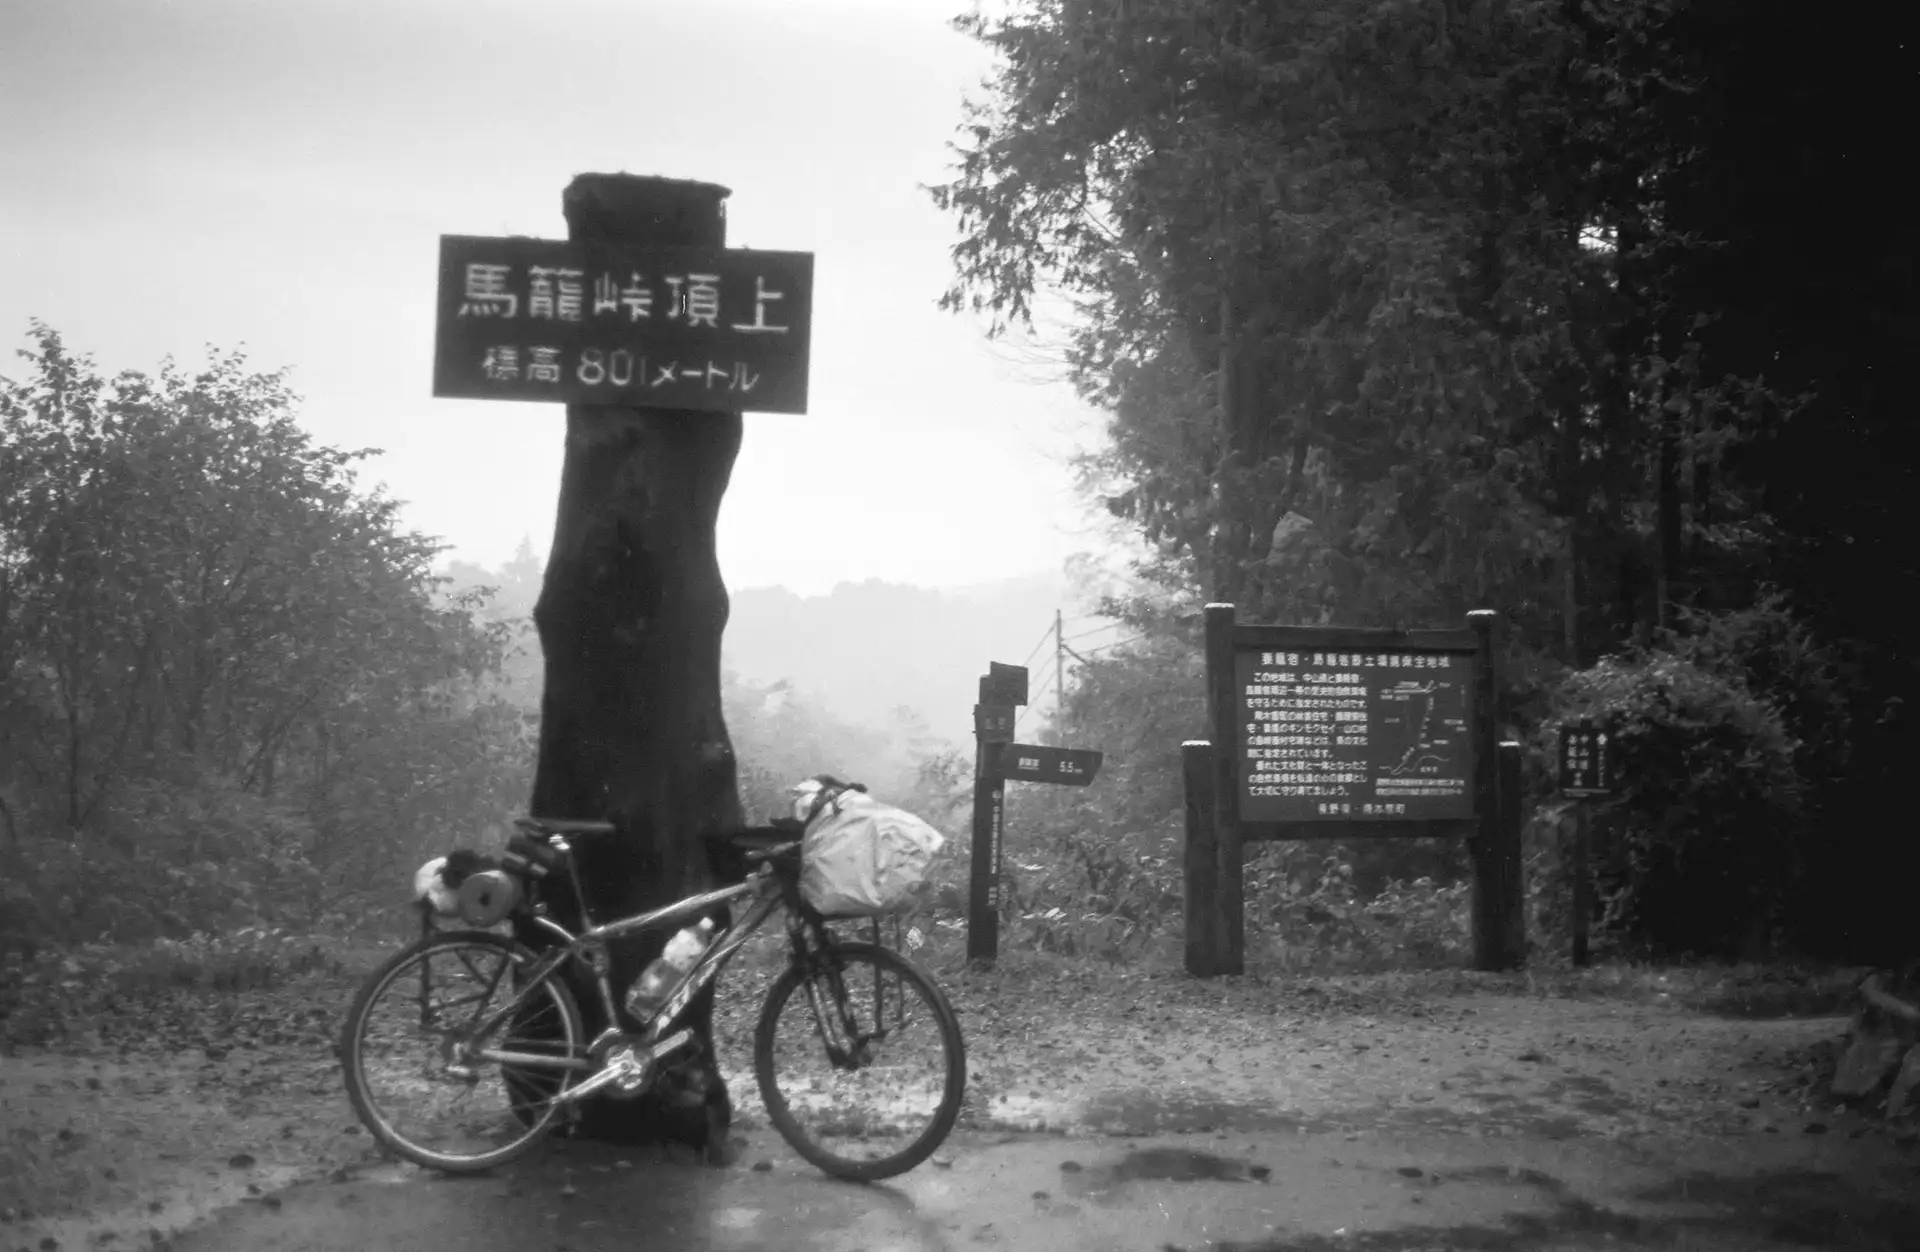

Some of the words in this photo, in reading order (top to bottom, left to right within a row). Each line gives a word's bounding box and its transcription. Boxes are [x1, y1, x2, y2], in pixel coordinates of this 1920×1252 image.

[458, 263, 789, 333] 馬籠峠頂上
